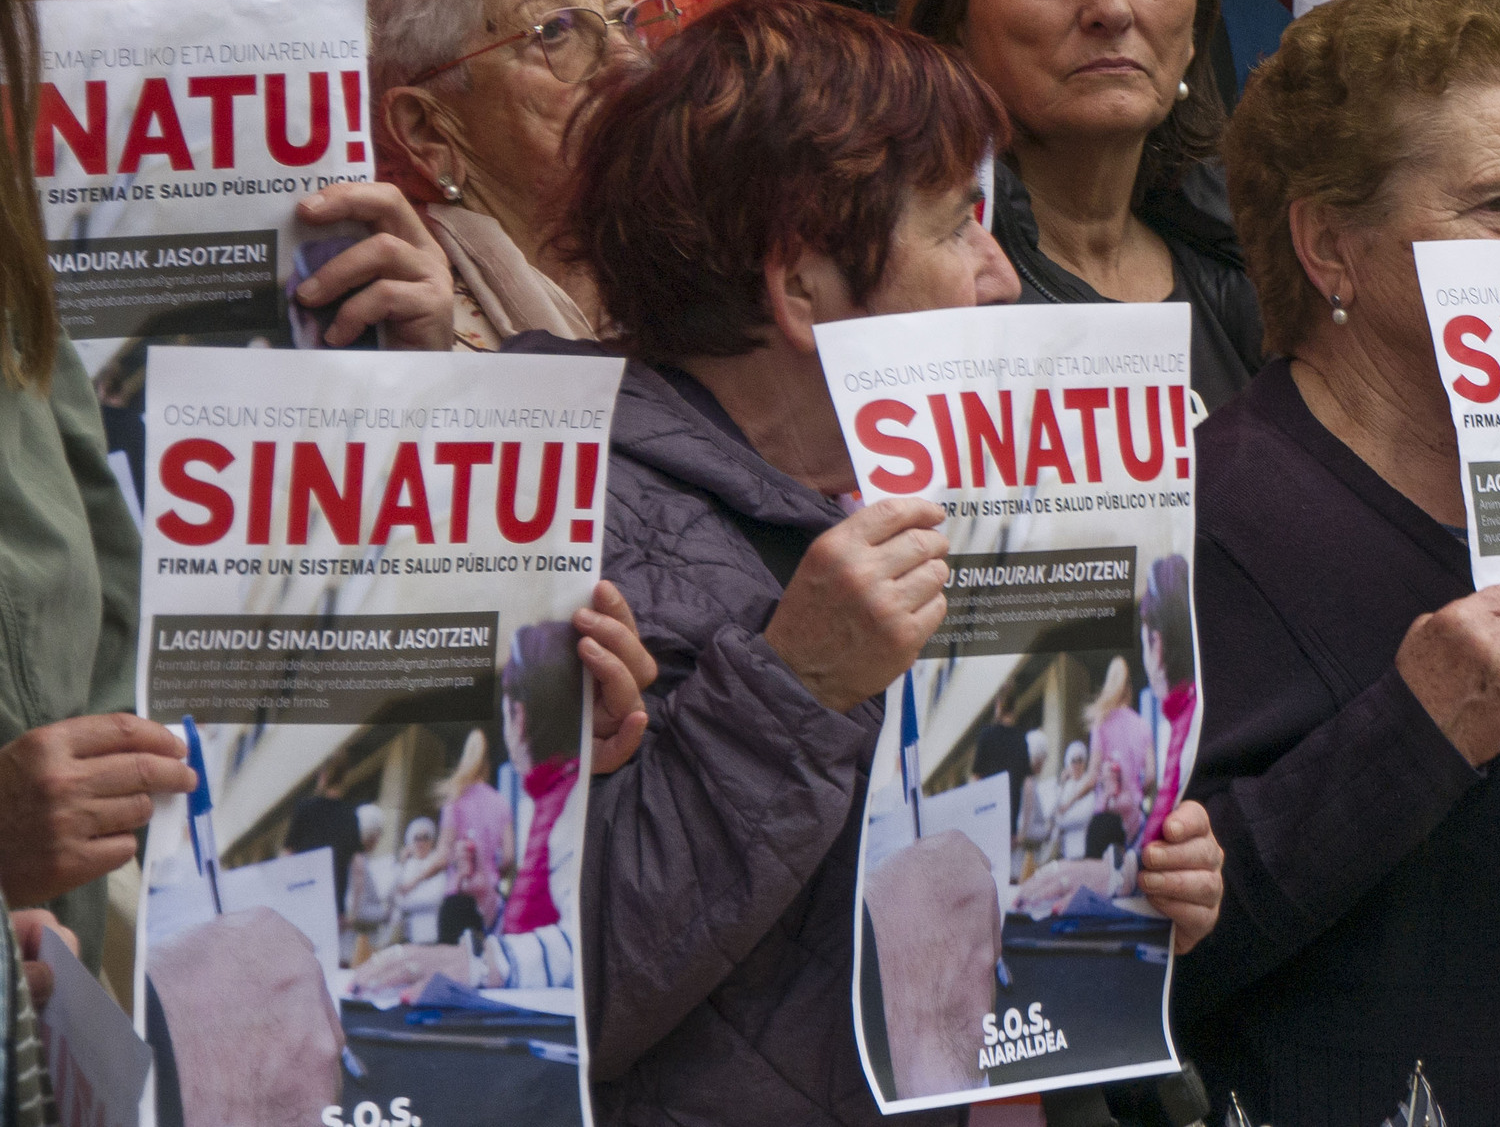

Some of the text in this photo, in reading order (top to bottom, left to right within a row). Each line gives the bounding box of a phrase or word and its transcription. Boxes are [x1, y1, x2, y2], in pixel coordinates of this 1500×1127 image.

[91, 39, 360, 68] PUBLIKO ETA DUINAREN ALDE
[2, 70, 366, 178] NATU!
[47, 185, 128, 205] SISTEMA
[131, 184, 155, 201] DE
[160, 181, 217, 200] SALUD
[223, 176, 296, 196] PÚBLICO
[300, 177, 313, 192] Y
[153, 244, 268, 268] JASOTZEN!
[1436, 287, 1500, 307] OSASUN
[844, 364, 926, 393] OSASUN
[926, 358, 1000, 382] SISTEMA
[1057, 356, 1080, 376] ETA
[1082, 354, 1151, 375] DUINAREN
[1153, 352, 1185, 373] ALDE
[163, 404, 605, 430] OSASUN SISTEMA PUBLIKO ETA DUINAREN ALDE
[1463, 414, 1500, 429] FIRMA
[854, 385, 1190, 495] SINATU!
[155, 437, 600, 547] SINATU!
[961, 501, 980, 517] UN
[982, 499, 1033, 516] SISTEMA
[1035, 497, 1051, 514] DE
[1055, 496, 1094, 512] SALUD
[1097, 491, 1146, 510] PÚBLICO
[1149, 493, 1157, 508] Y
[158, 558, 218, 575] FIRMA
[224, 558, 261, 575] POR
[267, 558, 294, 575] UN
[299, 558, 376, 575] SISTEMA
[380, 558, 400, 575] DE
[405, 557, 451, 574] SALUD
[456, 553, 518, 573] PÚBLICO
[522, 556, 532, 571] Y
[957, 564, 1048, 589] SINADURAK
[1047, 560, 1130, 584] JASOTZEN!
[158, 627, 490, 650] LAGUNDU SINADURAK JASOTZEN!
[203, 661, 221, 671] eta
[455, 676, 475, 688] para
[189, 698, 211, 708] con
[224, 696, 274, 710] recogida
[275, 696, 290, 708] de
[293, 696, 329, 708] firmas
[982, 1001, 1051, 1046] S.O.S.
[979, 1028, 1069, 1070] AIARALDEA
[321, 1096, 422, 1127] S.O.S.
